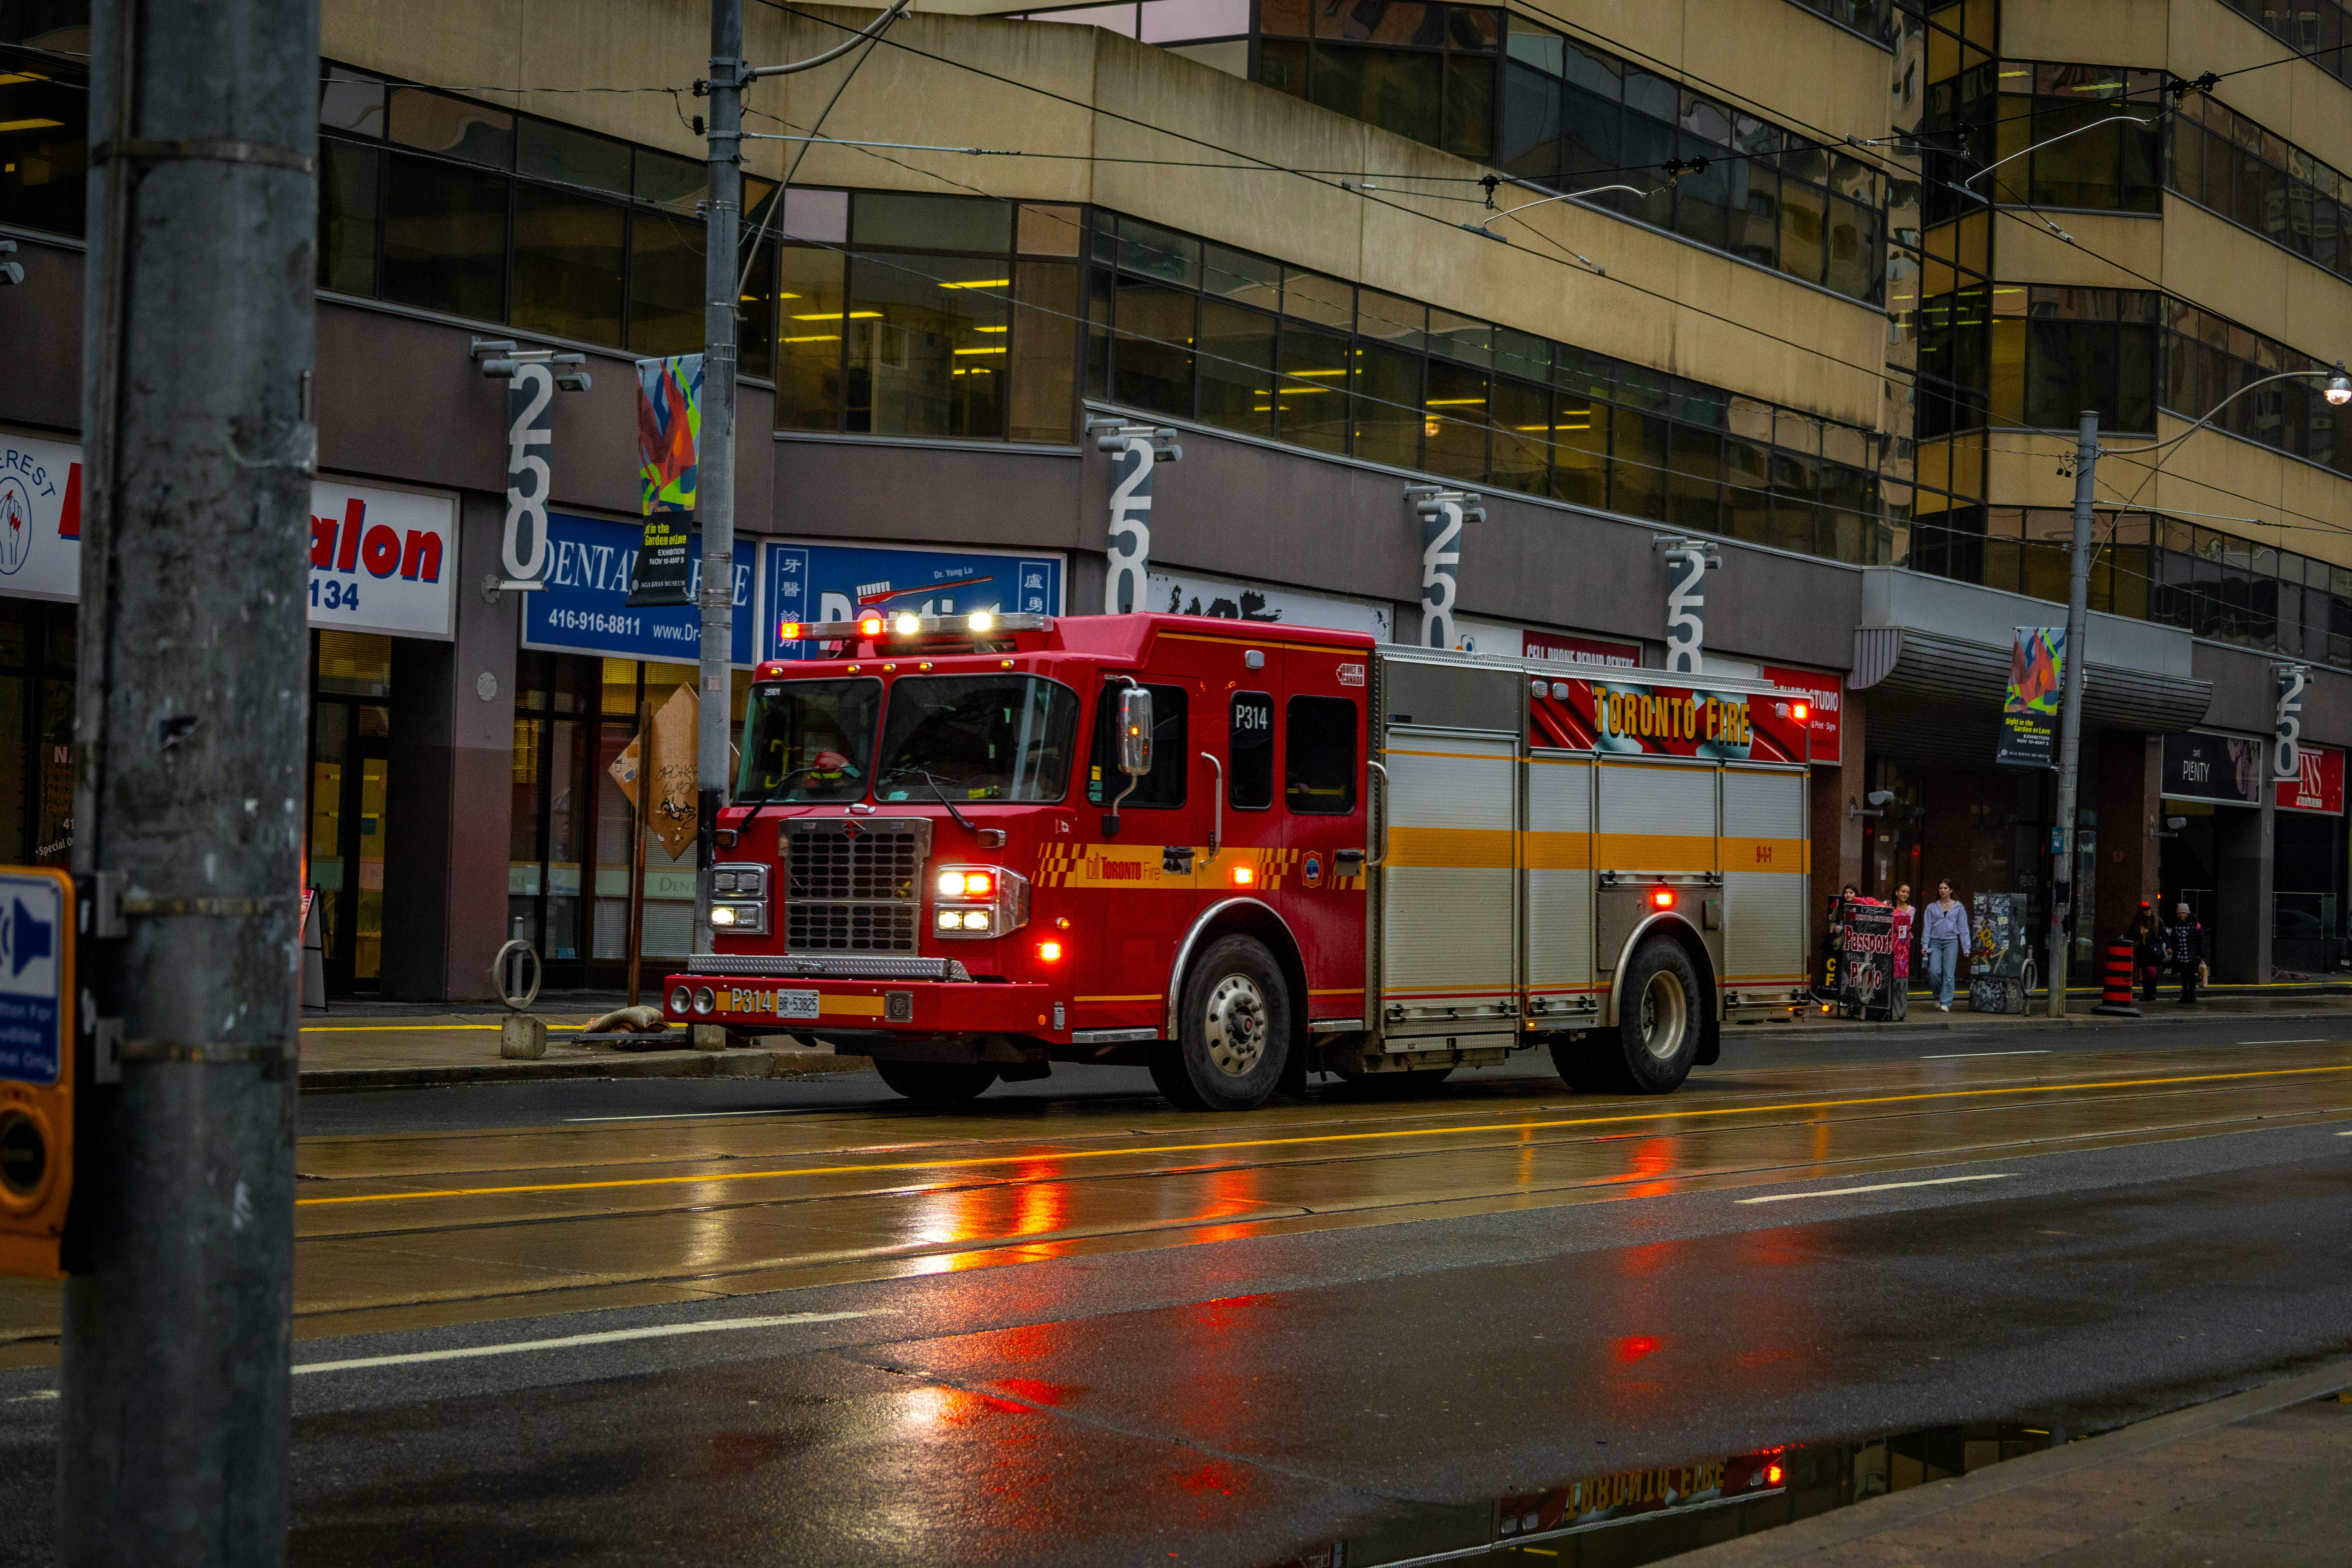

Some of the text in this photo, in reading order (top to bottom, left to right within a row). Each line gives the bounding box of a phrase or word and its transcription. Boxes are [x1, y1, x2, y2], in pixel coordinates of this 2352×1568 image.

[502, 364, 552, 579] 250
[657, 523, 670, 534] the
[1105, 438, 1154, 615] 250
[310, 498, 443, 584] alon
[645, 534, 687, 546] Garden of Love
[657, 548, 685, 556] EXHIBITION
[934, 566, 973, 579] Dr. Yong Lu
[548, 608, 640, 636] 416-916-8811
[653, 624, 701, 642] www.Dr-
[1809, 688, 1838, 711] STUDIO
[1236, 704, 1268, 730] P314
[1594, 686, 1751, 746] TORONTO FIRE
[1815, 720, 1824, 730] Print
[1826, 721, 1837, 732] Signs
[2005, 717, 2019, 726] Night
[2274, 673, 2304, 777] 250
[2183, 760, 2210, 782] PLENTY
[38, 838, 65, 857] Special
[1757, 846, 1771, 862] 9-1-1
[1101, 857, 1160, 880] TORONTO Fire
[661, 878, 695, 893] DENT
[1873, 915, 1893, 923] STUDIO
[1844, 925, 1893, 960] Passport
[731, 988, 771, 1013] P314
